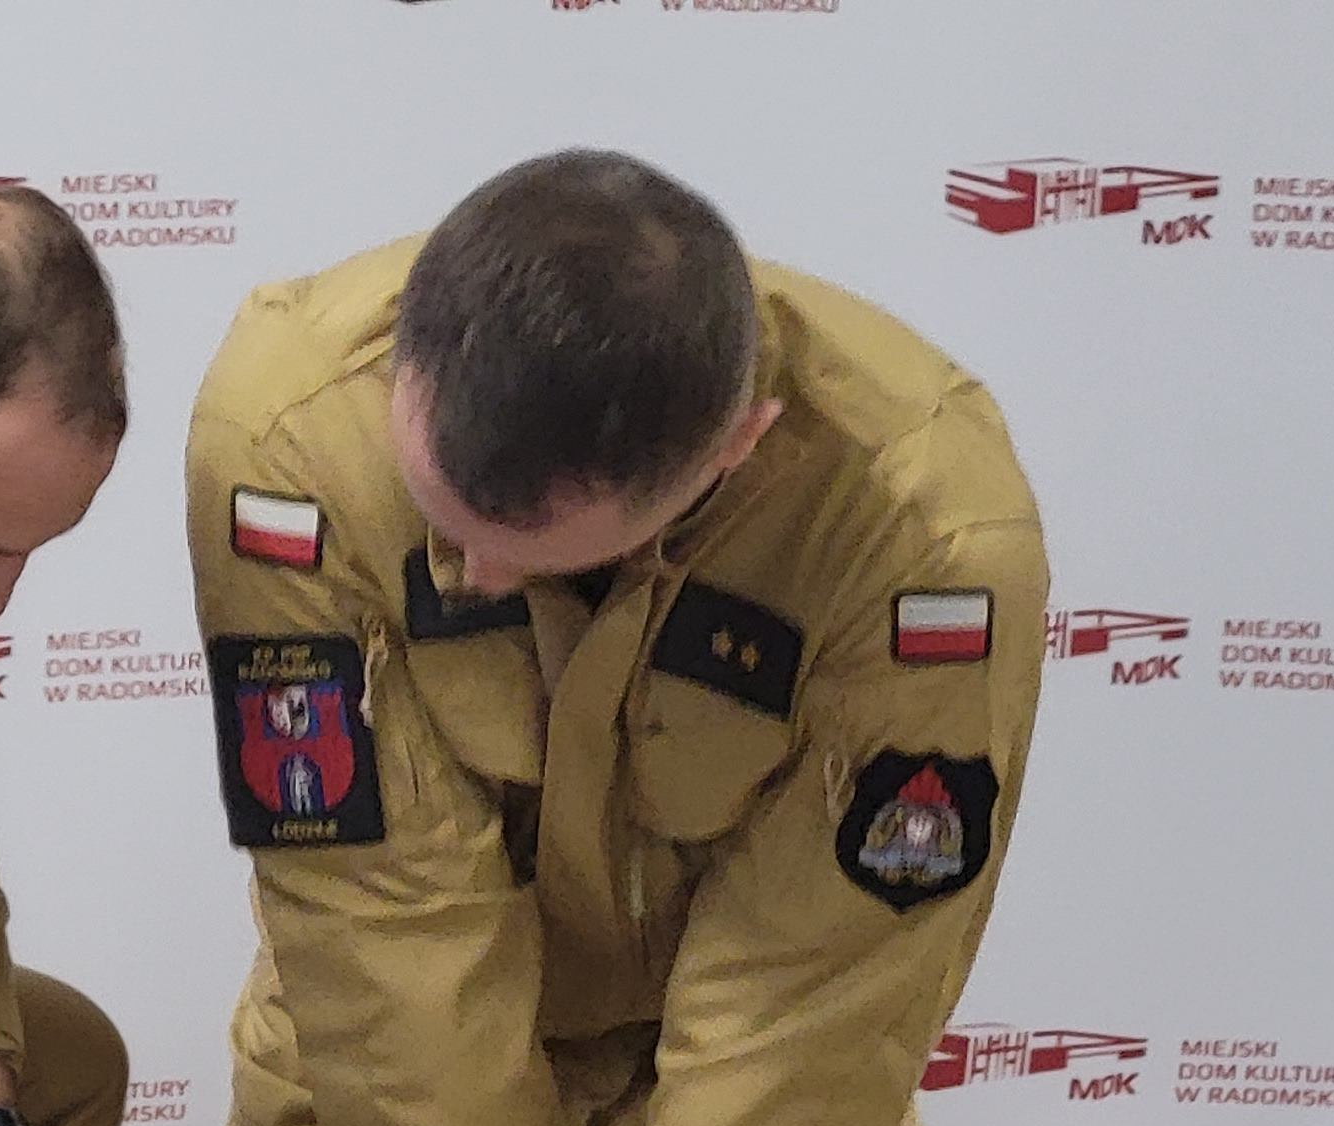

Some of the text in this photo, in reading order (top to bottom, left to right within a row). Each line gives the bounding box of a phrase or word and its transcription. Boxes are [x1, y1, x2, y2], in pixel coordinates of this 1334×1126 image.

[62, 174, 157, 194] MIEJSKI
[128, 199, 238, 220] KULTURY
[1253, 203, 1312, 225] DOM
[93, 226, 237, 247] RADOMSKU
[1141, 213, 1213, 248] MDK
[1251, 229, 1276, 251] W
[1222, 619, 1321, 639] MIEJSKI
[46, 630, 141, 650] MIEJSKI
[46, 652, 202, 677] DOM KULTUR
[1222, 644, 1282, 665] DOM
[1110, 655, 1183, 685] MDK
[1219, 670, 1246, 687] W
[44, 685, 68, 703] W
[1181, 1040, 1277, 1057] MIEJSKI
[1178, 1063, 1237, 1080] DOM
[129, 1079, 190, 1098] TURY
[1069, 1072, 1139, 1100] MDK
[1176, 1087, 1201, 1103] W
